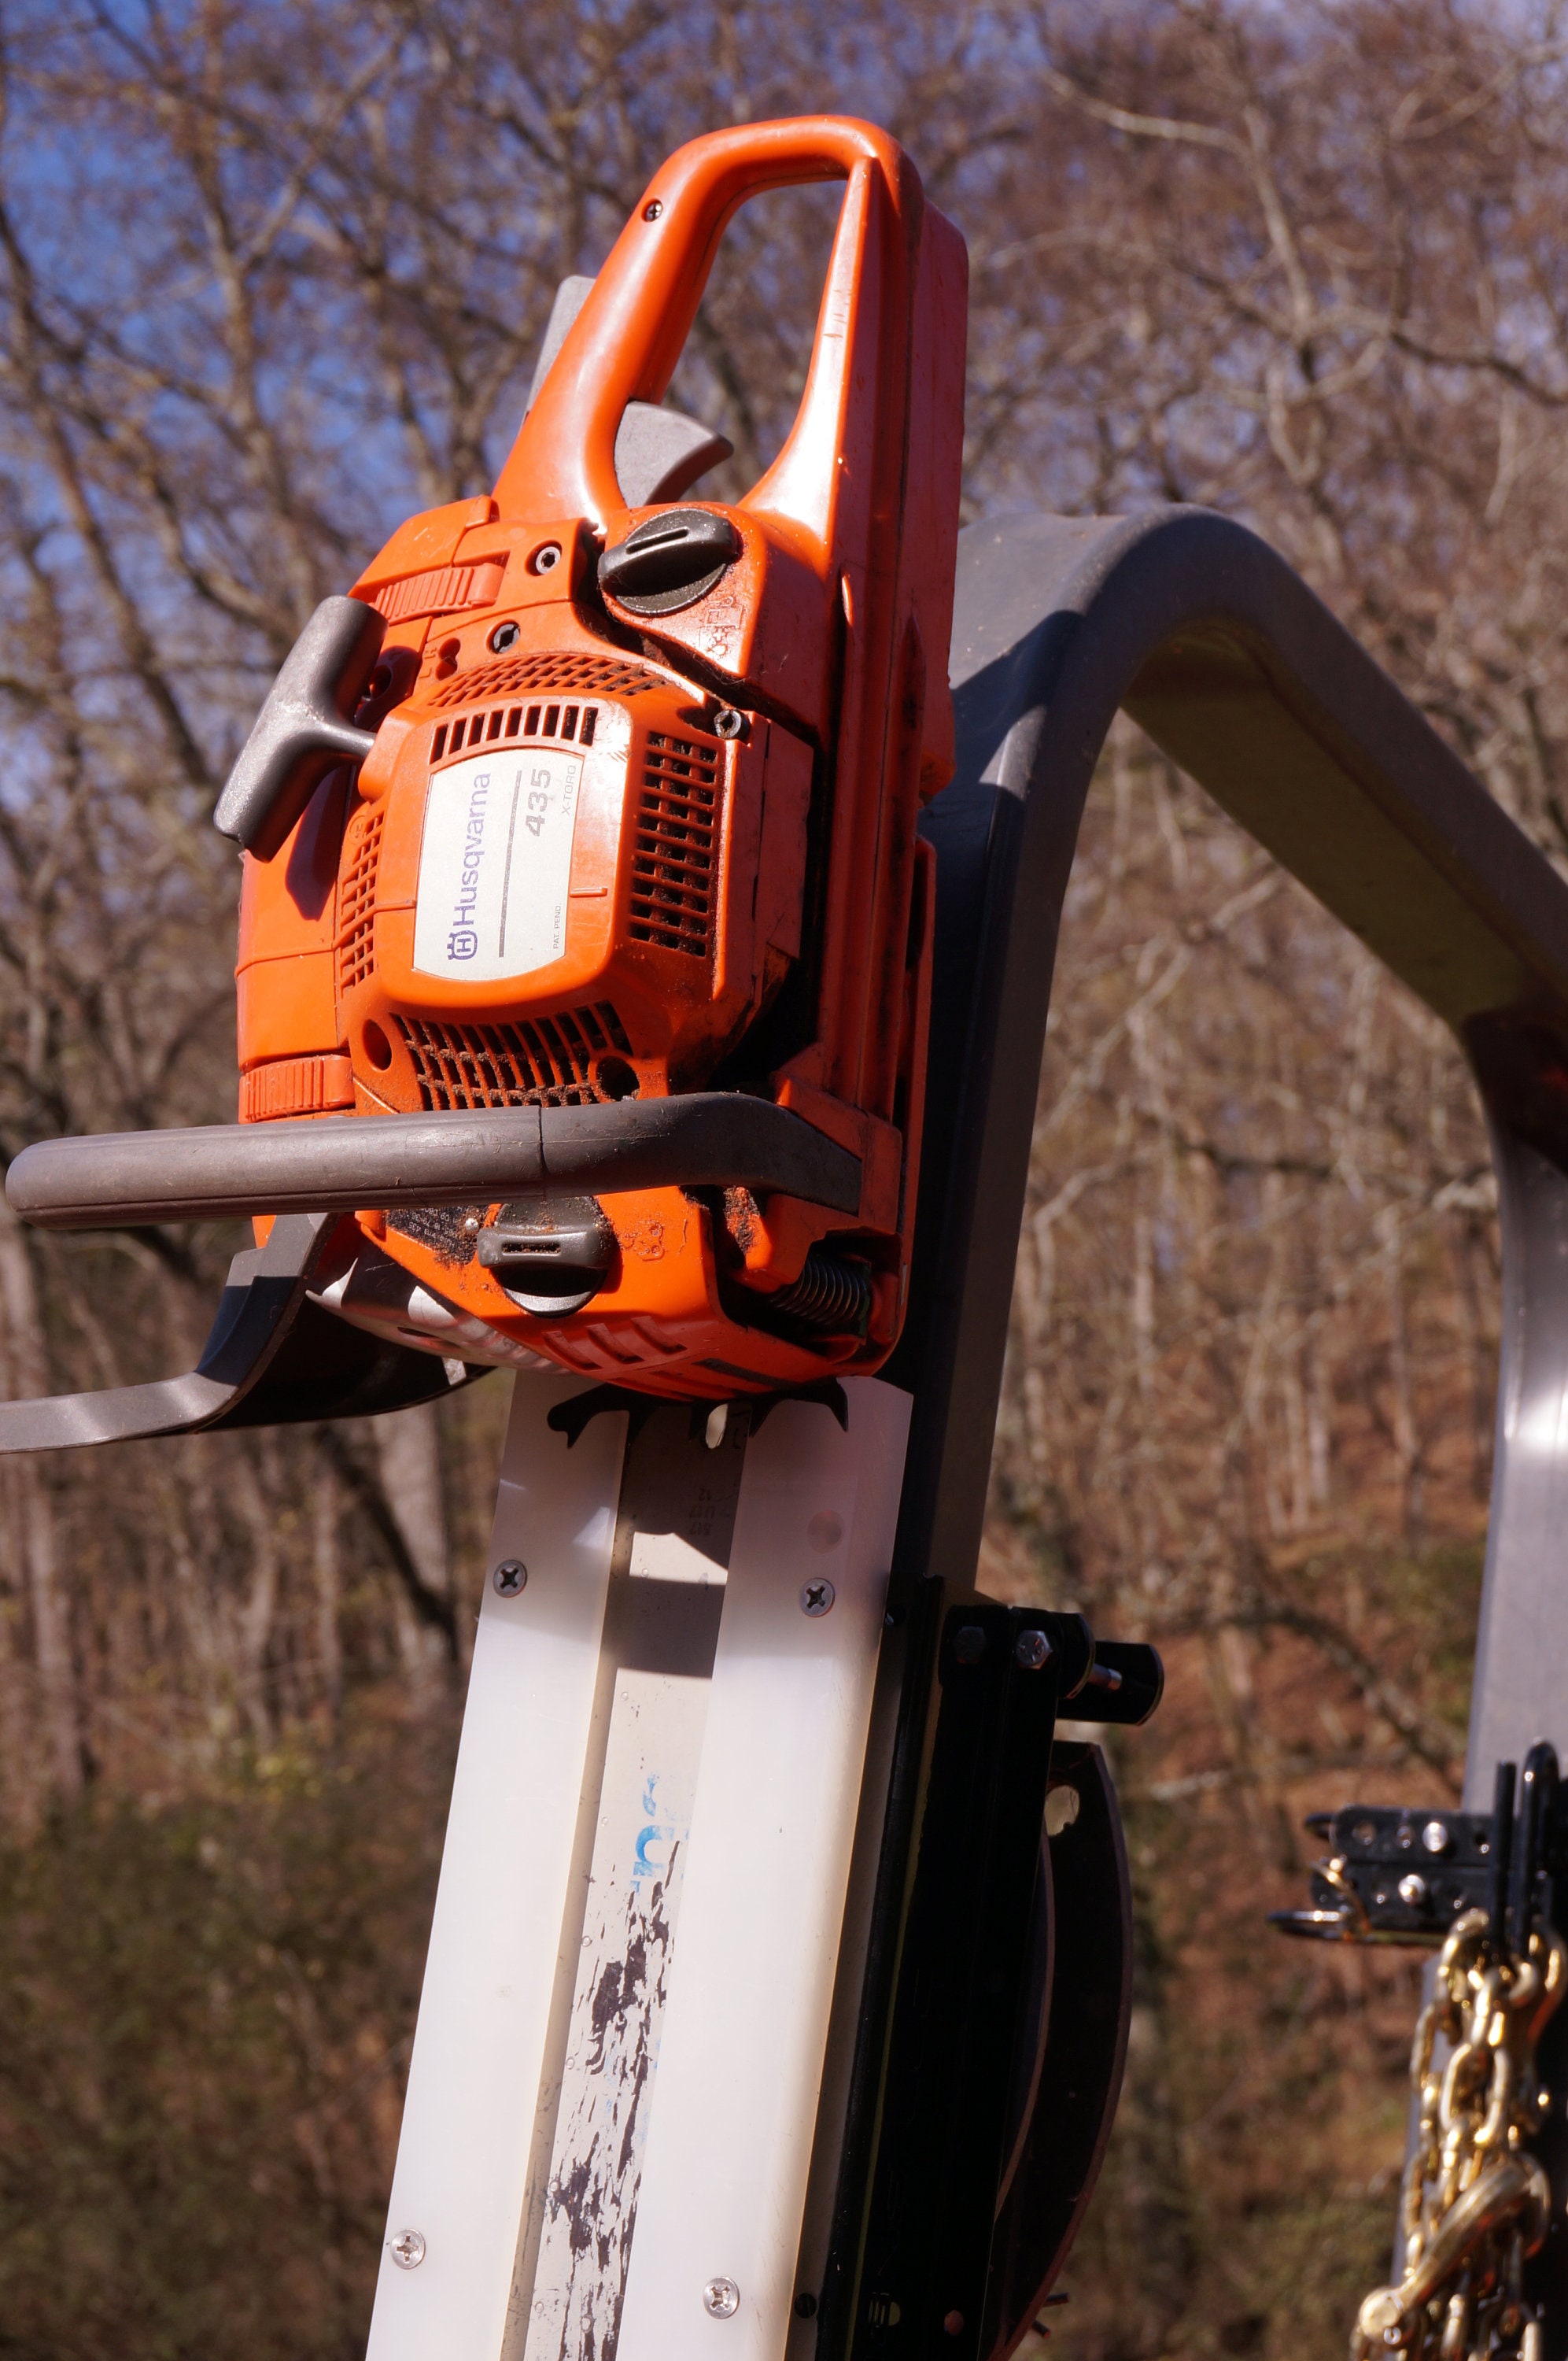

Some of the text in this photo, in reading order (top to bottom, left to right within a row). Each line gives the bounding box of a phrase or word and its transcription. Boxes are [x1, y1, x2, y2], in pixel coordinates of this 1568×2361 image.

[525, 768, 552, 837] 435
[561, 765, 576, 815] X-TORQ
[452, 773, 492, 926] Husqvarna
[553, 902, 562, 929] PEND.
